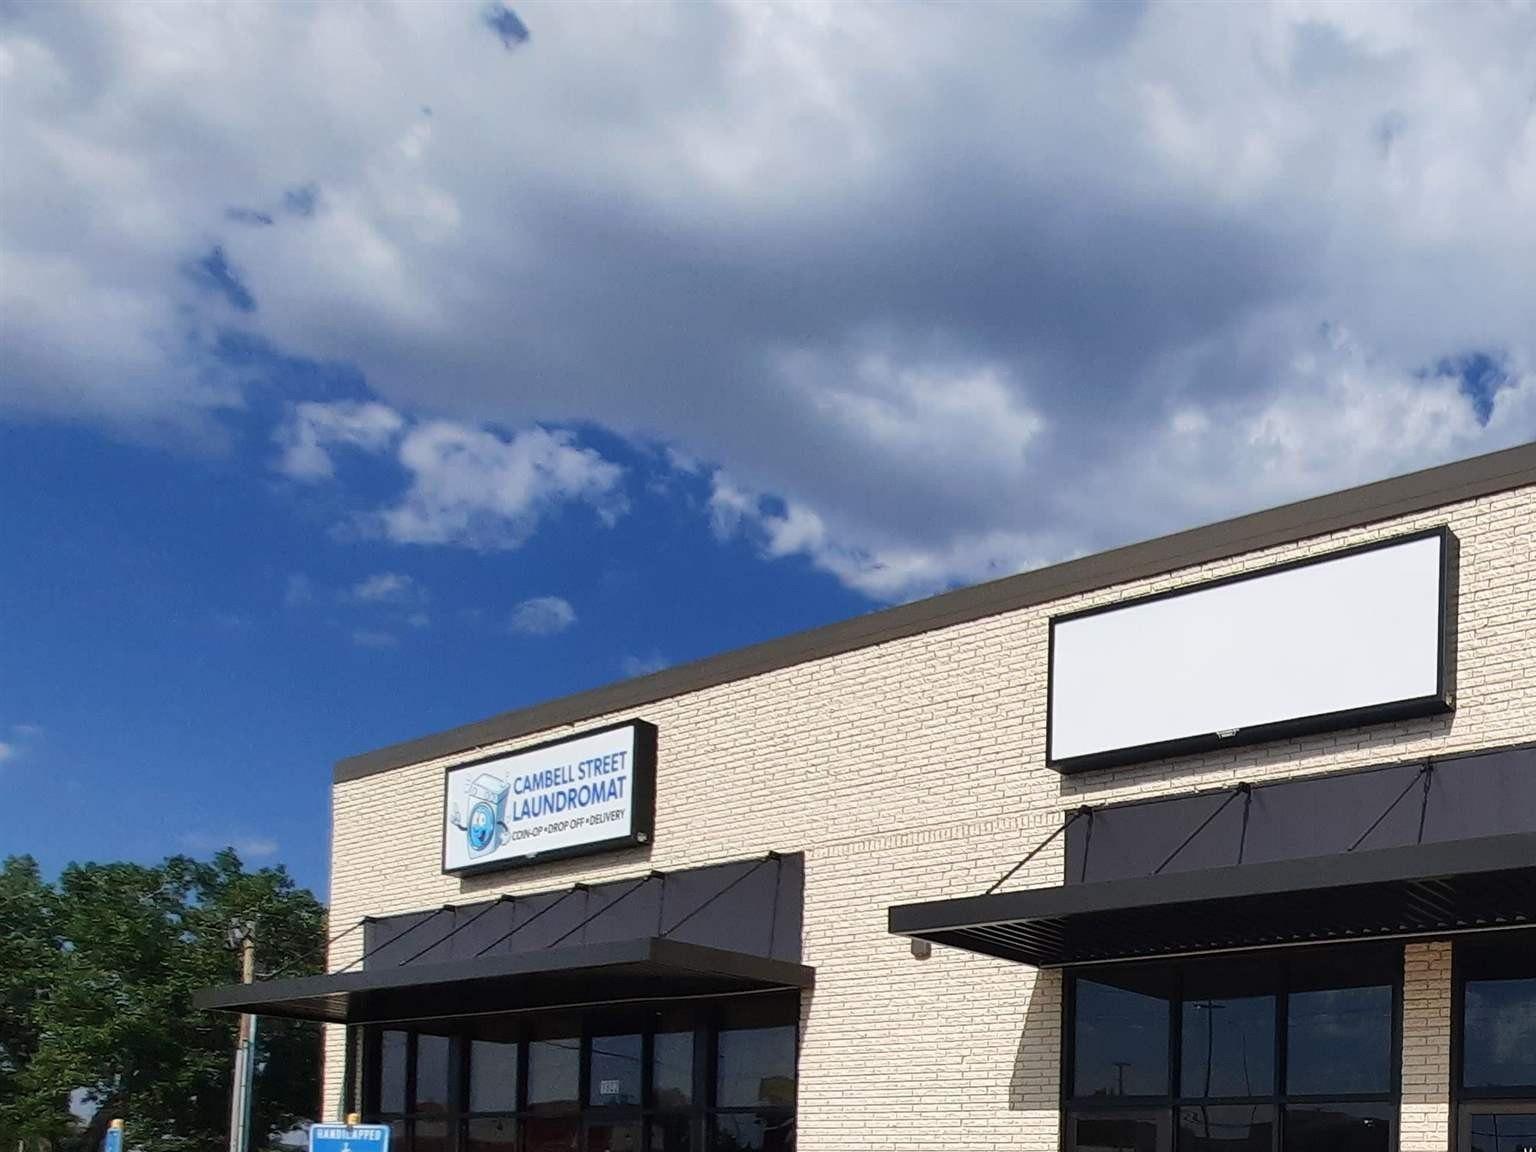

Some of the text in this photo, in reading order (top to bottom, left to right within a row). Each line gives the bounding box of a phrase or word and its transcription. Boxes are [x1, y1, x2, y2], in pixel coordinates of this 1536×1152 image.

[513, 751, 627, 795] CAMBELL STREET
[512, 776, 627, 821] LAUNDROMAT
